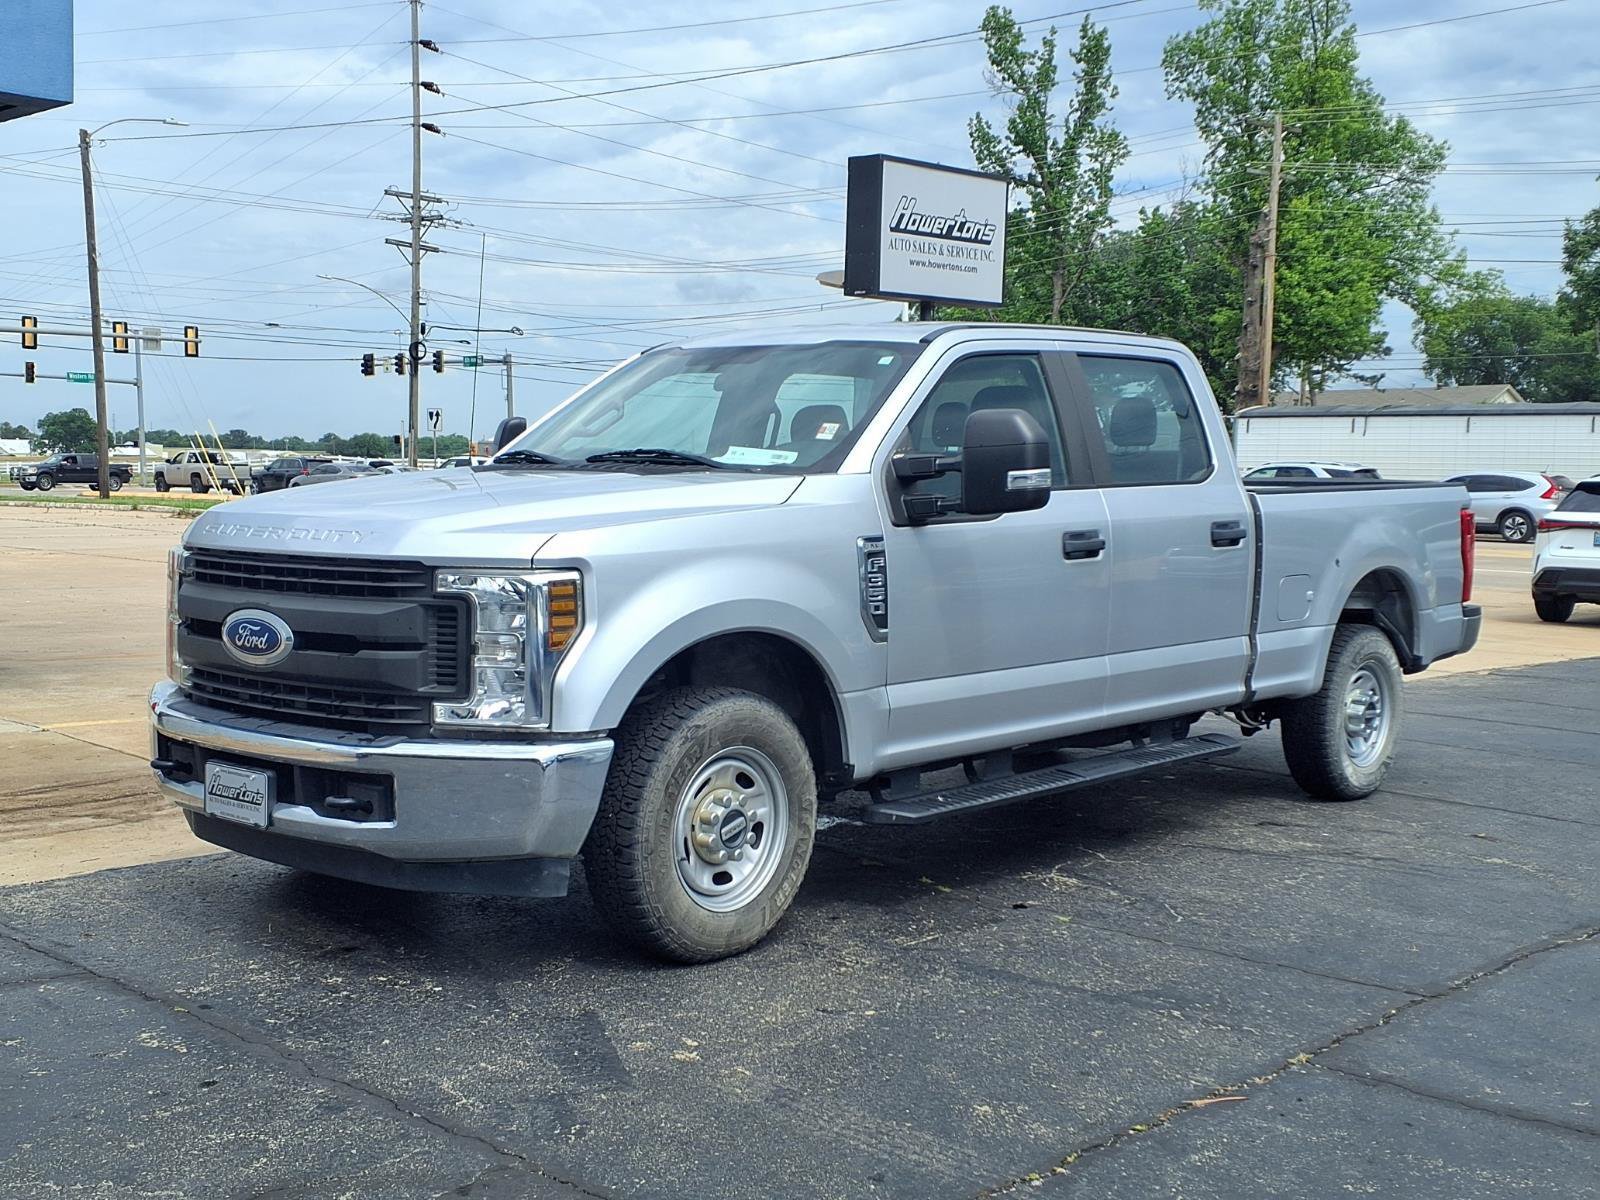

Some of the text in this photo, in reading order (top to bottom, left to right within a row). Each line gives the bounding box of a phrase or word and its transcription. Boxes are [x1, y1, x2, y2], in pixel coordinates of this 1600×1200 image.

[889, 195, 996, 245] Howerton's
[888, 238, 996, 263] AUTO SALES & SERVICE INC.
[909, 258, 978, 274] www.howertons.com
[203, 523, 364, 544] SUPER DUTY
[235, 623, 269, 649] Ford
[208, 774, 264, 806] Howerton's
